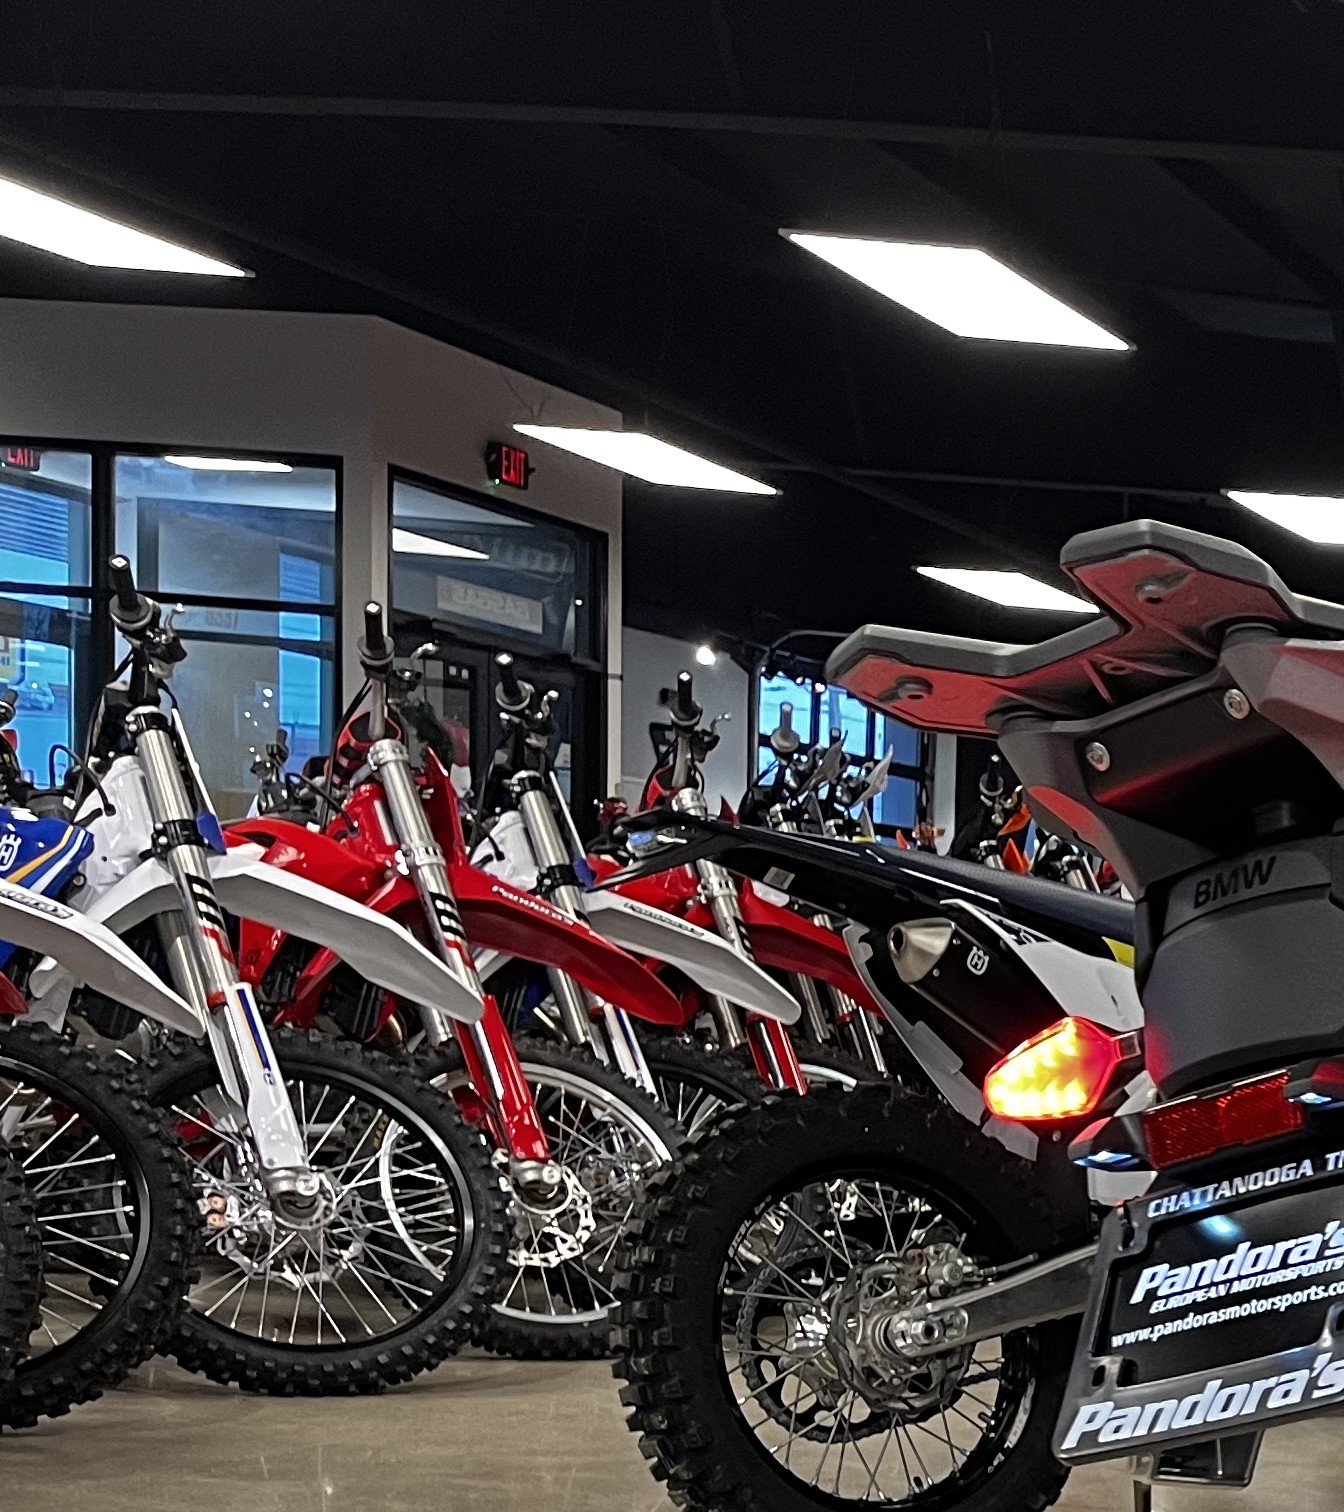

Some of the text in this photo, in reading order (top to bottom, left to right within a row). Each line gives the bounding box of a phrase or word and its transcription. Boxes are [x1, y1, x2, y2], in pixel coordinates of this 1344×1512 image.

[501, 445, 527, 487] EXIT
[1193, 855, 1277, 910] BMW
[1147, 1162, 1314, 1219] CHATTANOOGA
[1149, 1283, 1228, 1314] EUROPEAN
